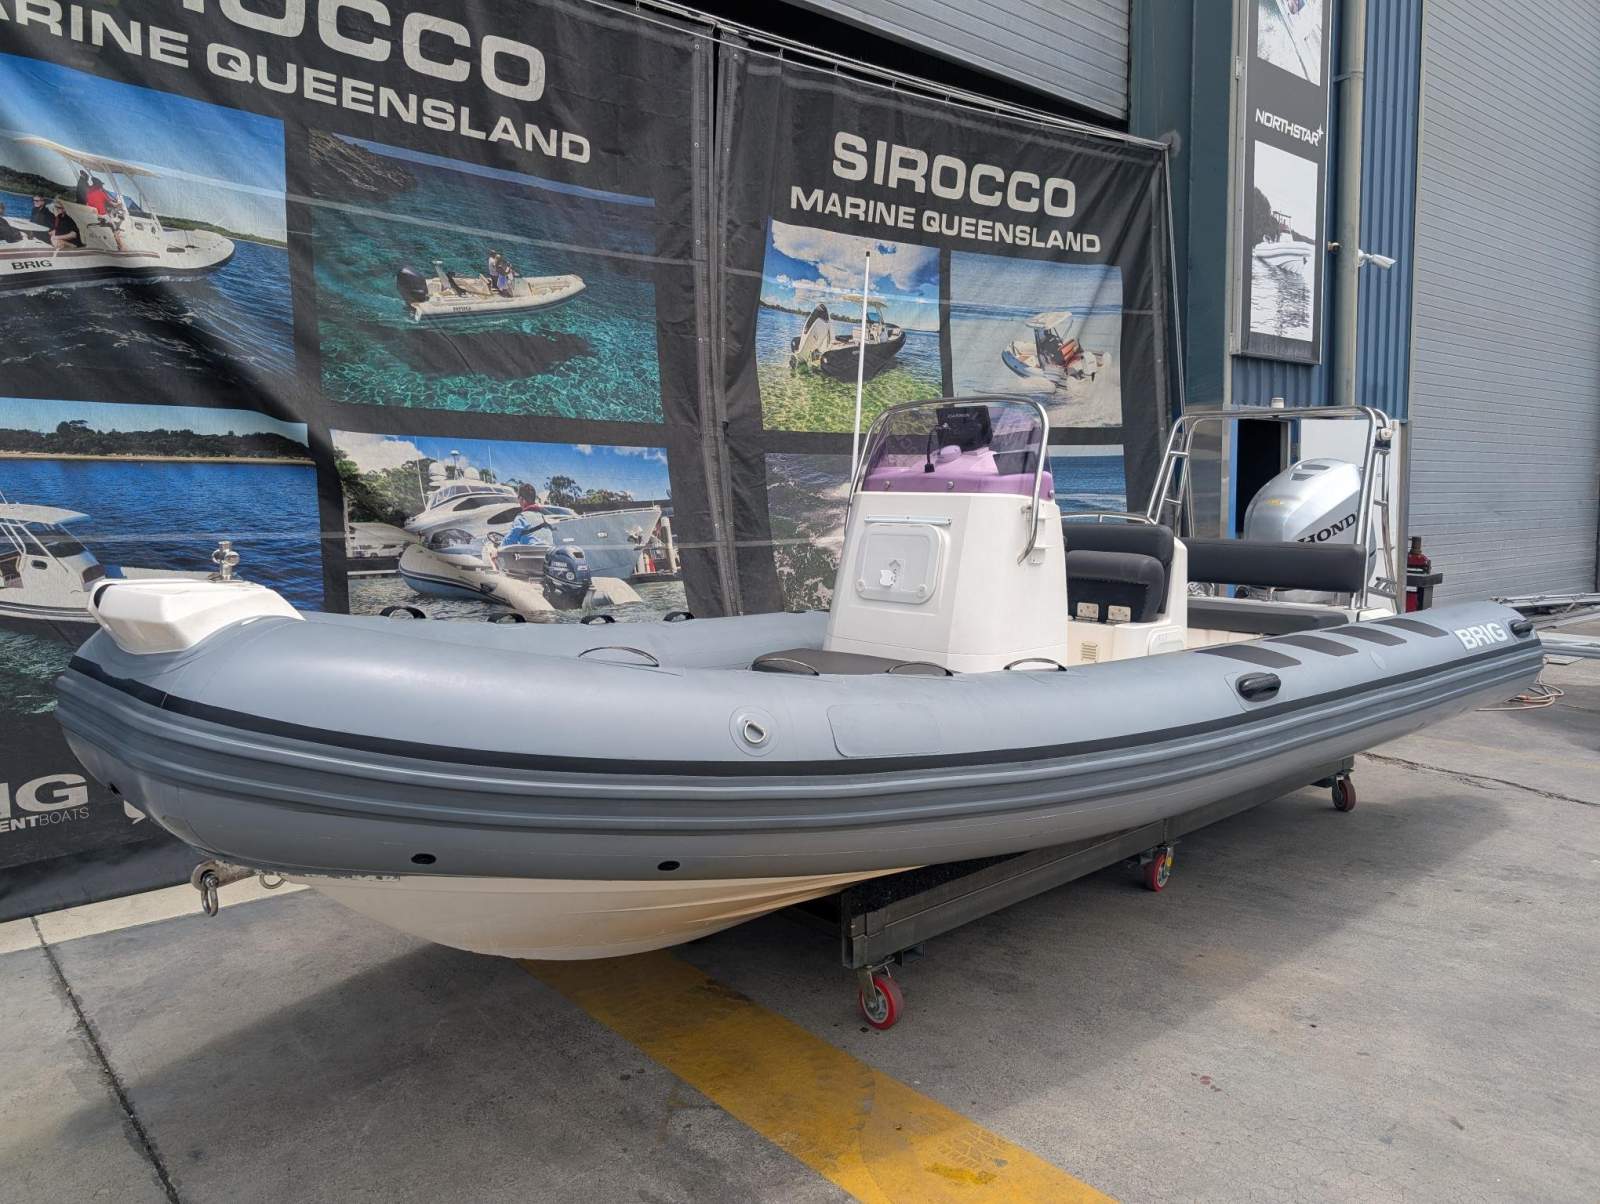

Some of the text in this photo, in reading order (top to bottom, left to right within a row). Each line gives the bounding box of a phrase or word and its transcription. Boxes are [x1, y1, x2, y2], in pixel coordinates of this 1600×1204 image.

[0, 0, 591, 164] RINE QUEENSLAND
[1255, 107, 1319, 147] NORTHSTAR
[832, 131, 1076, 218] SIROCCO
[790, 185, 1101, 253] MARINE QUEENSLAND
[11, 260, 53, 270] BRIG
[1297, 512, 1357, 543] HOND
[1455, 622, 1508, 650] BRIG
